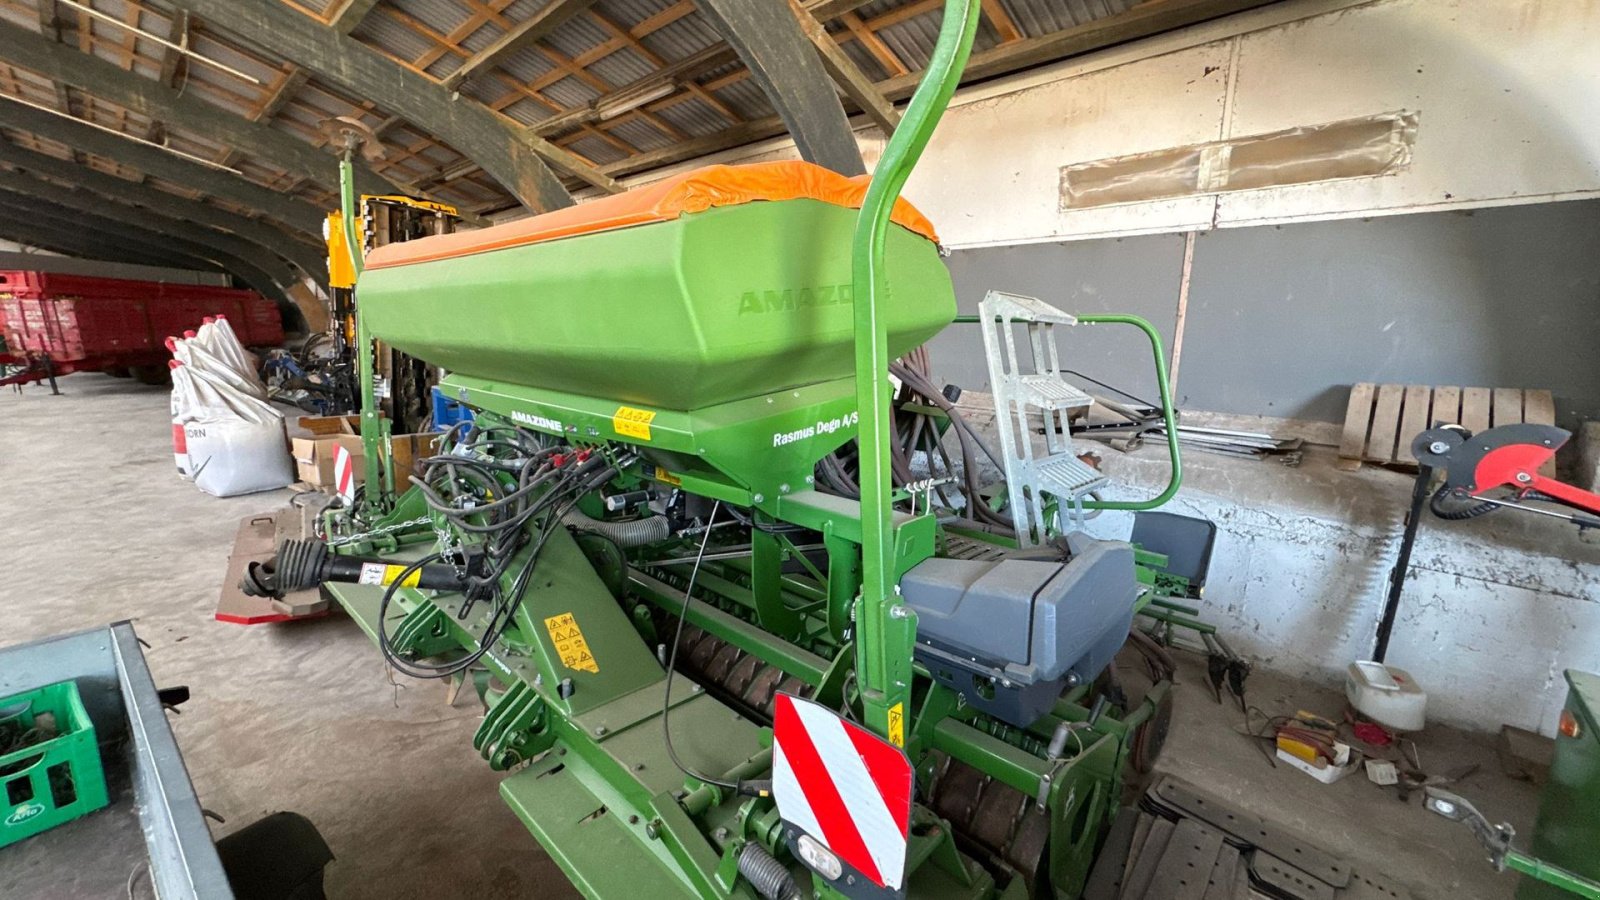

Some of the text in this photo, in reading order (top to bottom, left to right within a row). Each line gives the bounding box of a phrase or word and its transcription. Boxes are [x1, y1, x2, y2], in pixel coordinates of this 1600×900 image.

[511, 411, 563, 432] AMAZONE
[773, 411, 859, 447] Rasmus Degn A/S
